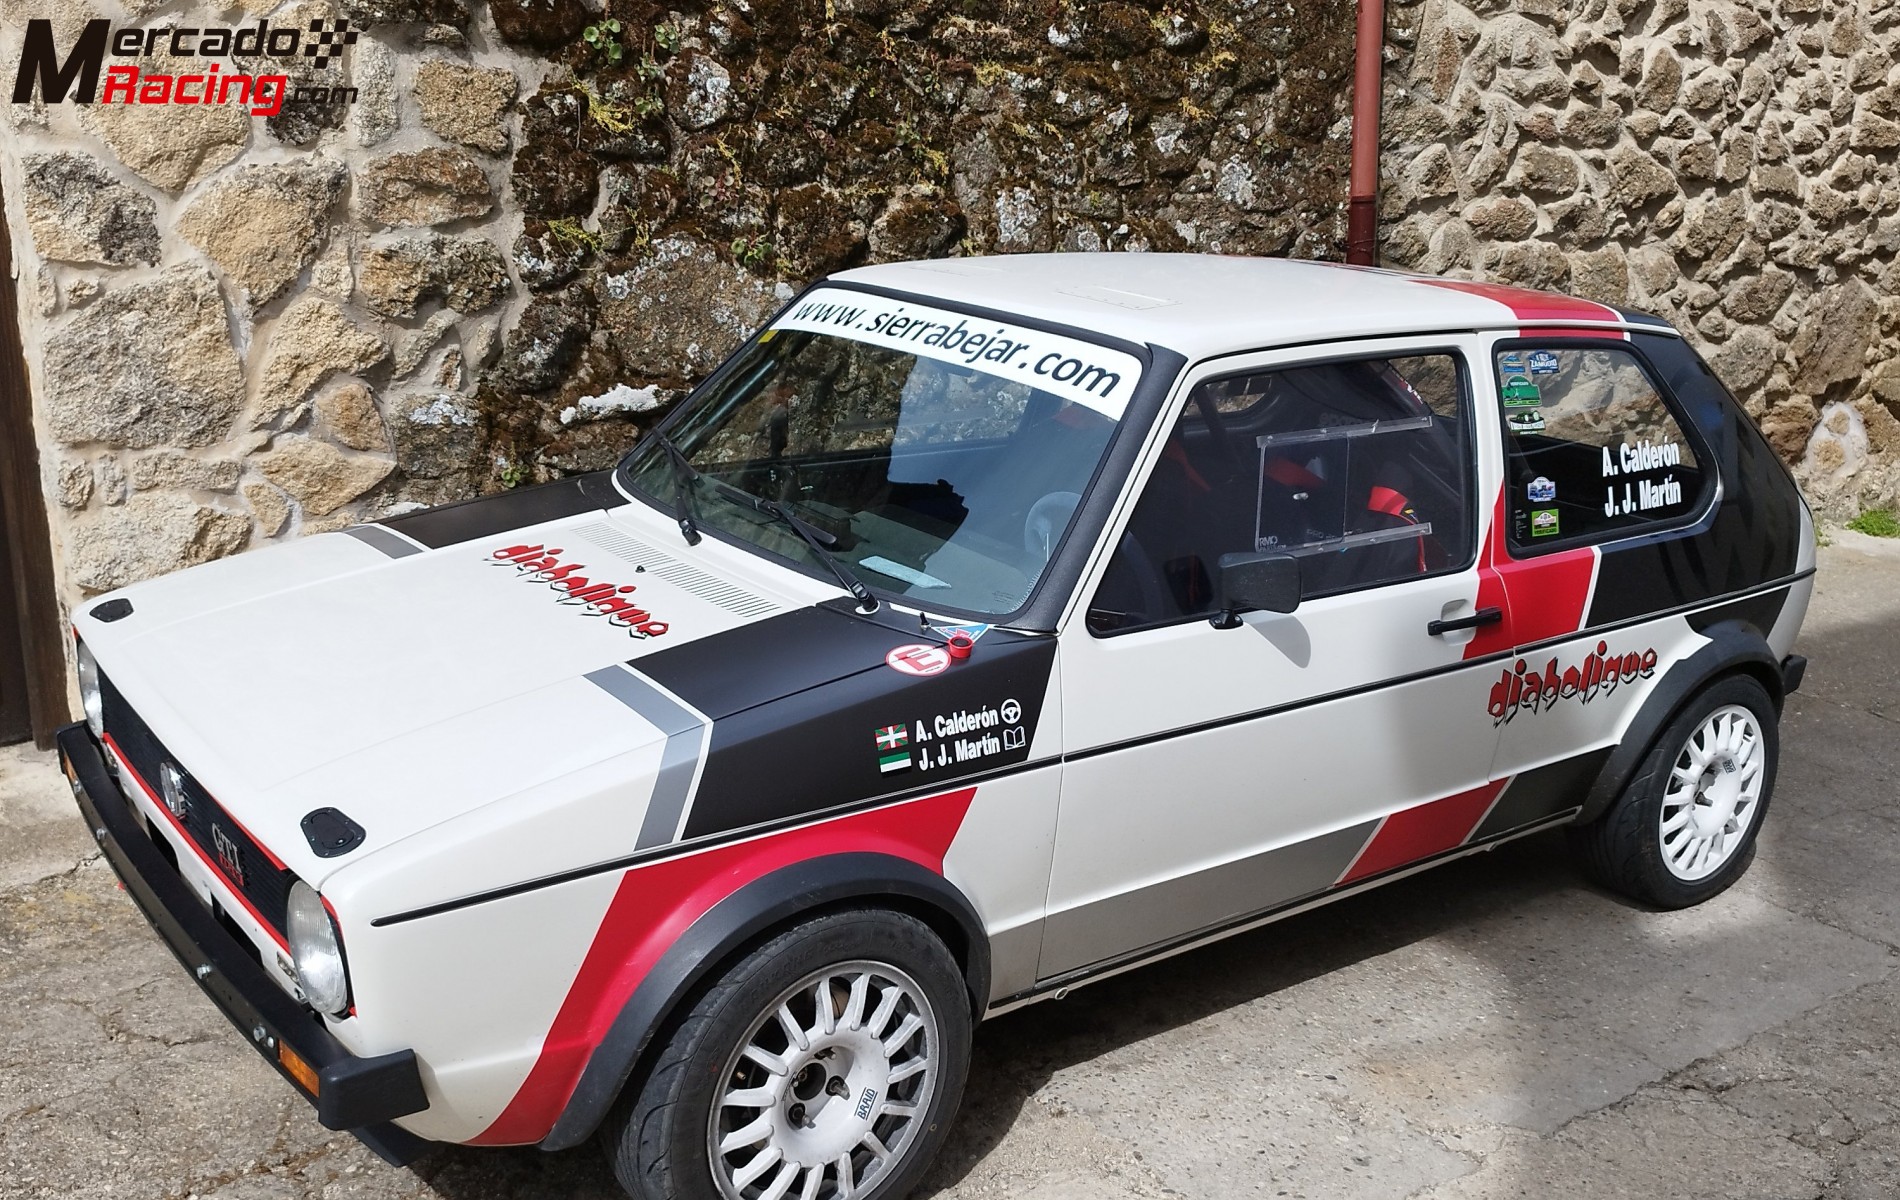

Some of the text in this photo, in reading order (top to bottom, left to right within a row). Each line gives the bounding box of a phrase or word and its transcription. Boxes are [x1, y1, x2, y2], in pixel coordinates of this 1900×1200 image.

[792, 301, 1122, 399] www.sierrabejar.com
[1602, 436, 1681, 477] A. Calderón
[1604, 474, 1682, 518] J. J. Martín
[482, 543, 669, 640] diabolique
[1487, 639, 1658, 728] diabolique
[915, 704, 999, 743] A. Calderón
[918, 732, 1001, 771] J. J. Martín
[212, 822, 242, 873] GTI
[857, 1088, 876, 1119] BRAID
